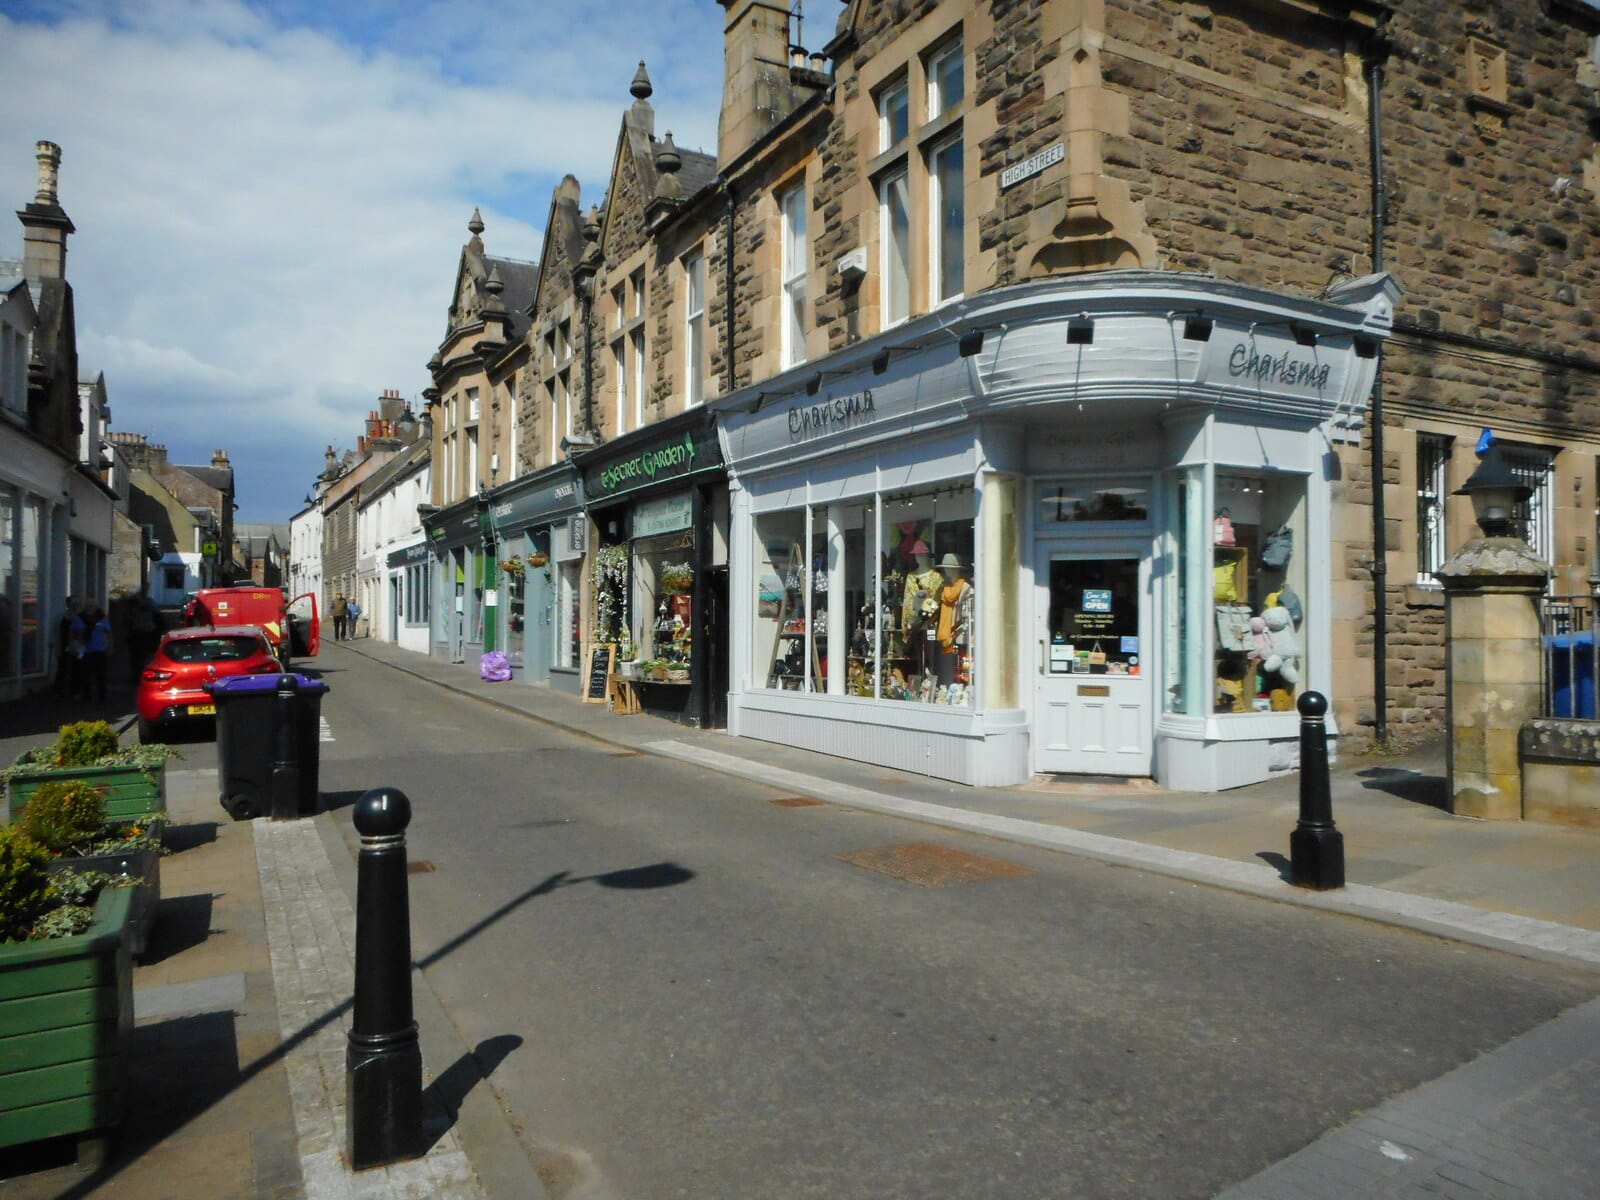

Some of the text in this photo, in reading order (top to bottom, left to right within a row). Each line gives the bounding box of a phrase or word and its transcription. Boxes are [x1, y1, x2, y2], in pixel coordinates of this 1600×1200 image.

[1004, 145, 1064, 185] HIGH STREET
[1229, 343, 1331, 388] Charisma
[788, 389, 876, 434] Charisma
[1085, 602, 1109, 610] OPEN
